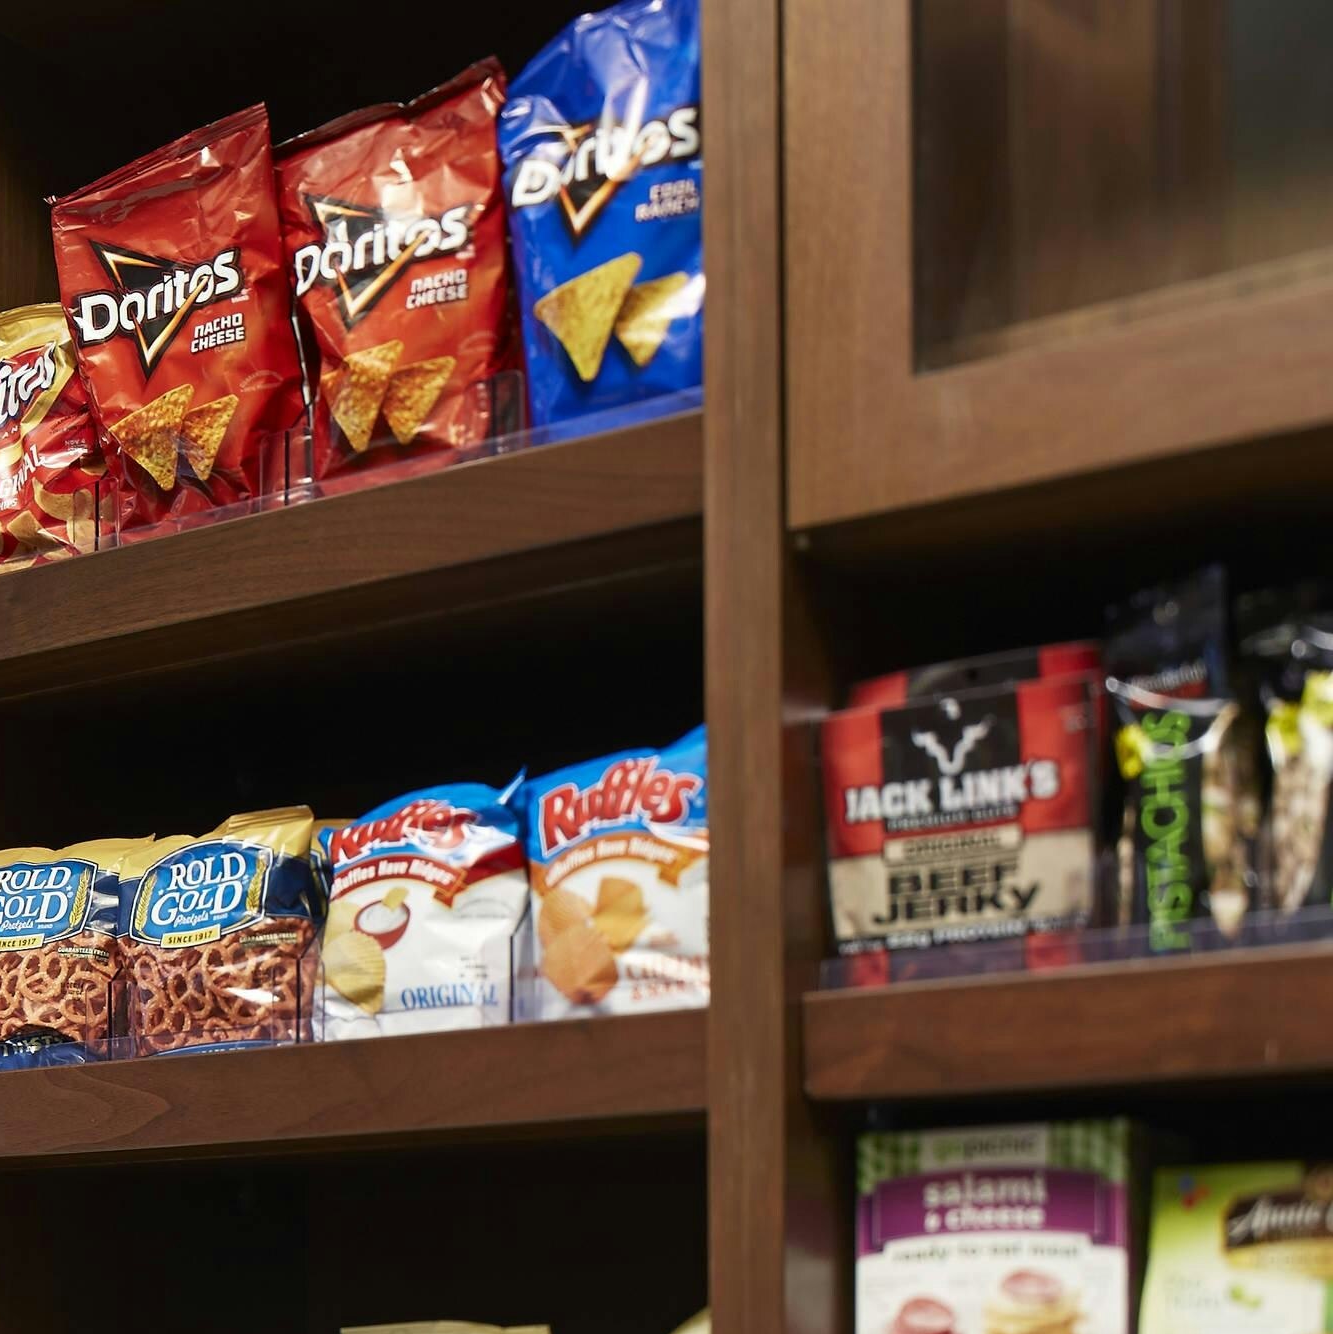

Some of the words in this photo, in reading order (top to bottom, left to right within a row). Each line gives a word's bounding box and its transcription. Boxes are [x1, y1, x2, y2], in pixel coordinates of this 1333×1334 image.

[295, 205, 468, 297] Doritos
[80, 250, 240, 342] Doritos
[406, 284, 469, 310] CHEESE
[410, 268, 467, 293] NACHO
[190, 326, 246, 353] CHEESE
[193, 312, 244, 339] NACHO
[539, 756, 703, 858] Ruffles
[845, 778, 933, 824] JACK
[939, 758, 1061, 812] LINK'S
[170, 852, 247, 891] ROLD
[378, 860, 408, 877] Have
[889, 861, 1019, 895] BEEF
[151, 881, 243, 926] GOLD
[874, 880, 1040, 925] JERKY
[18, 937, 37, 947] 1917
[168, 935, 193, 944] SINCE
[194, 931, 213, 941] 1917
[923, 1170, 1047, 1208] salami
[944, 1203, 1045, 1230] cheese
